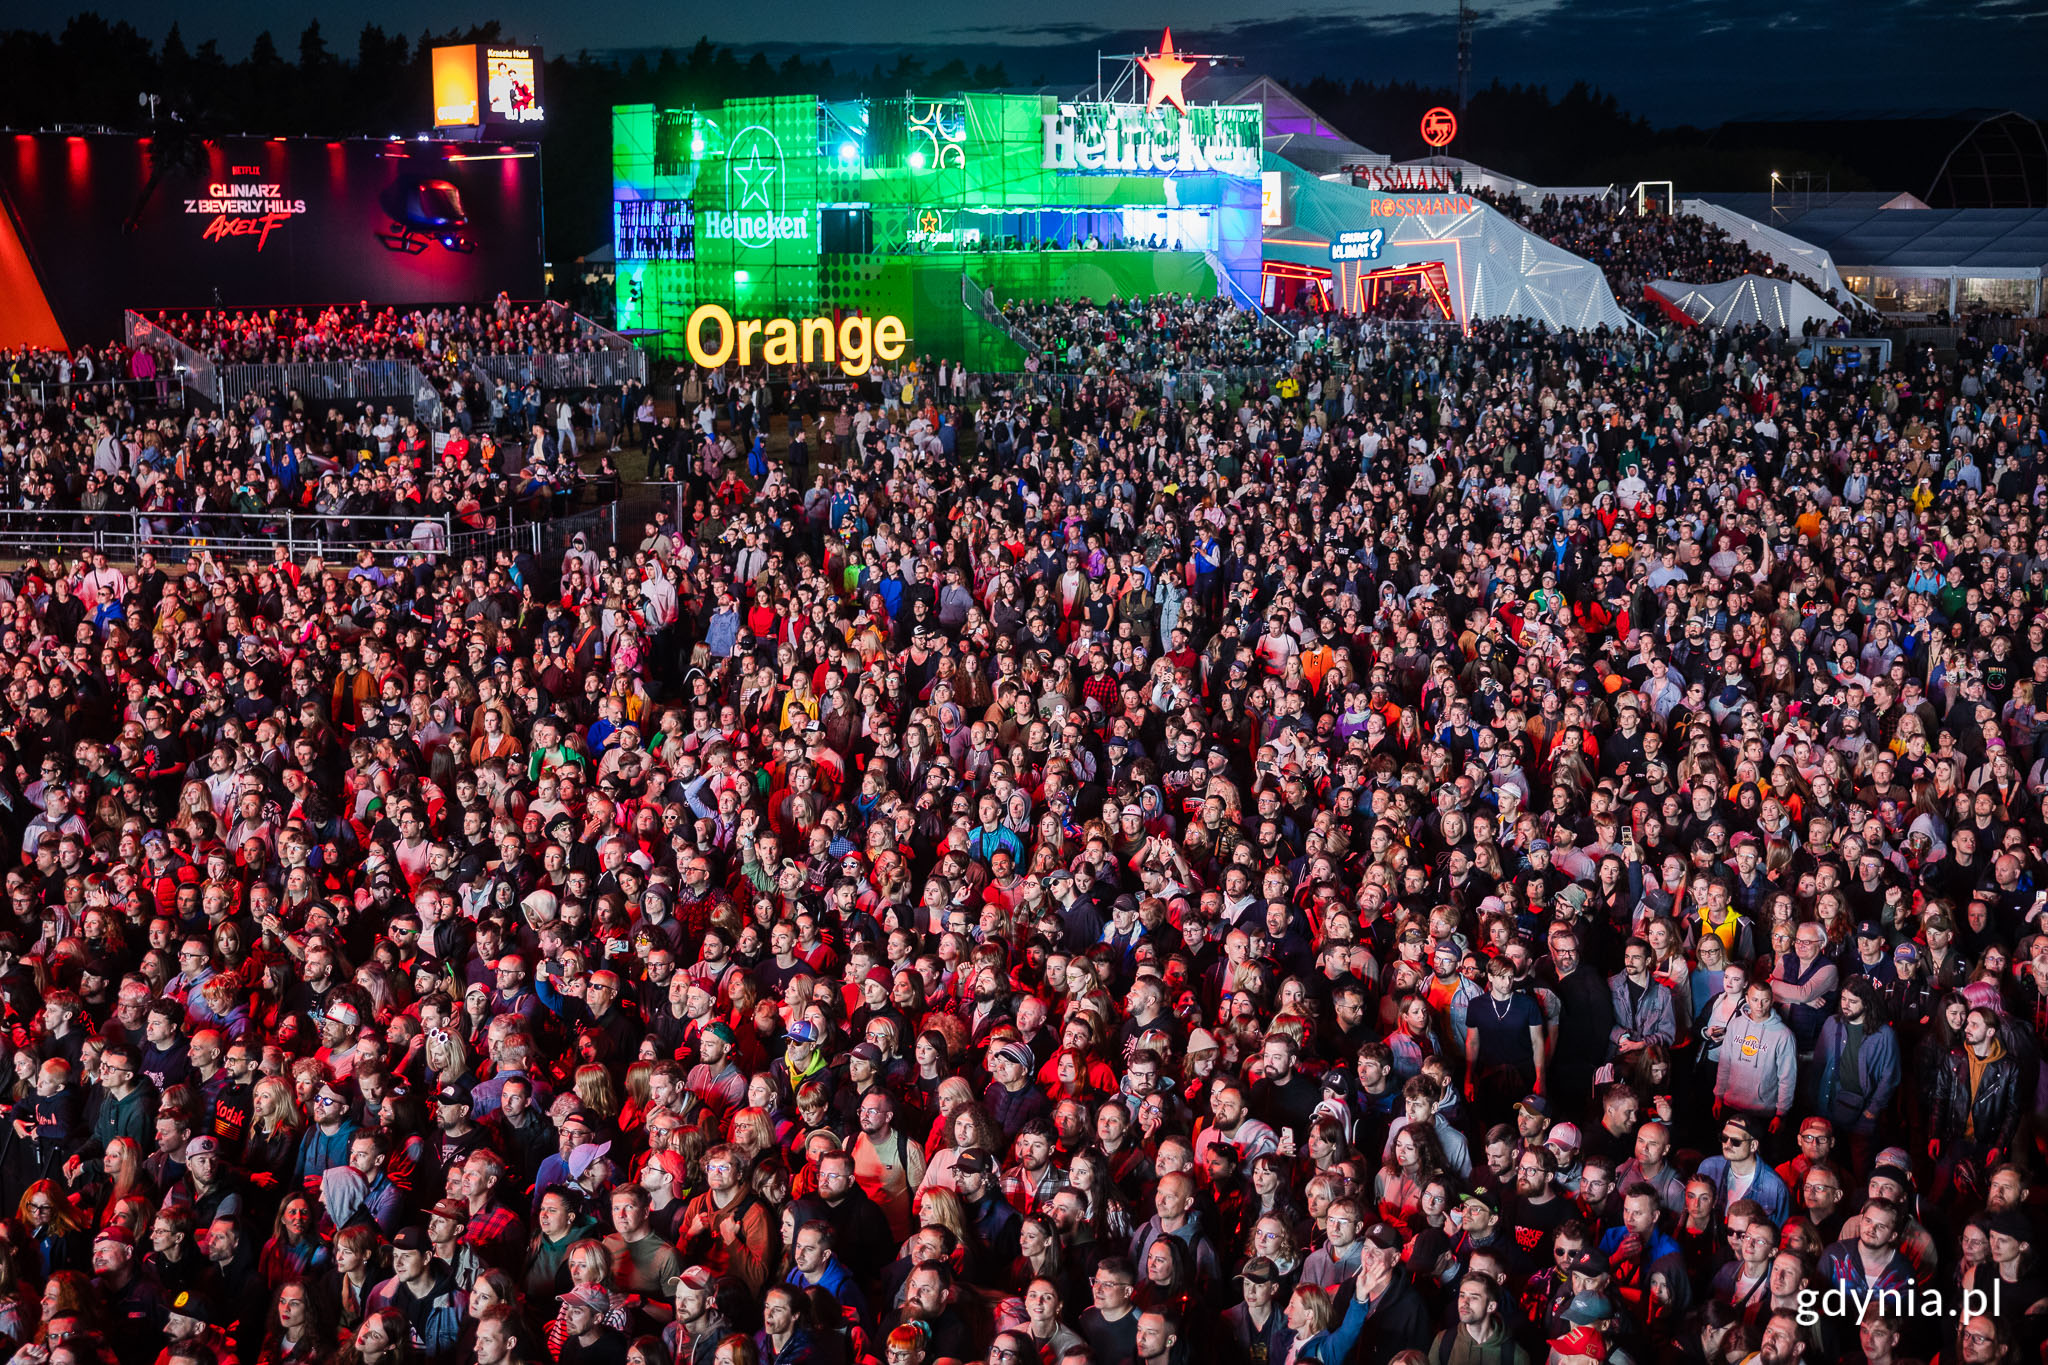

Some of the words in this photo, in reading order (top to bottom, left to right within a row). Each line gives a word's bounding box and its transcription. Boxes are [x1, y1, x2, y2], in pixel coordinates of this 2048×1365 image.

[1040, 113, 1262, 178] Heineken
[232, 166, 260, 175] NETFLIX
[209, 183, 281, 197] GLINIARZ
[184, 200, 197, 213] Z
[198, 200, 263, 213] BEVERLY
[264, 200, 306, 213] HILLS
[1370, 197, 1472, 217] ROSSMANN
[202, 214, 262, 243] AXEL
[258, 212, 291, 252] F
[704, 209, 808, 239] Heineken
[686, 303, 907, 377] Orange
[216, 1099, 245, 1127] Kodak
